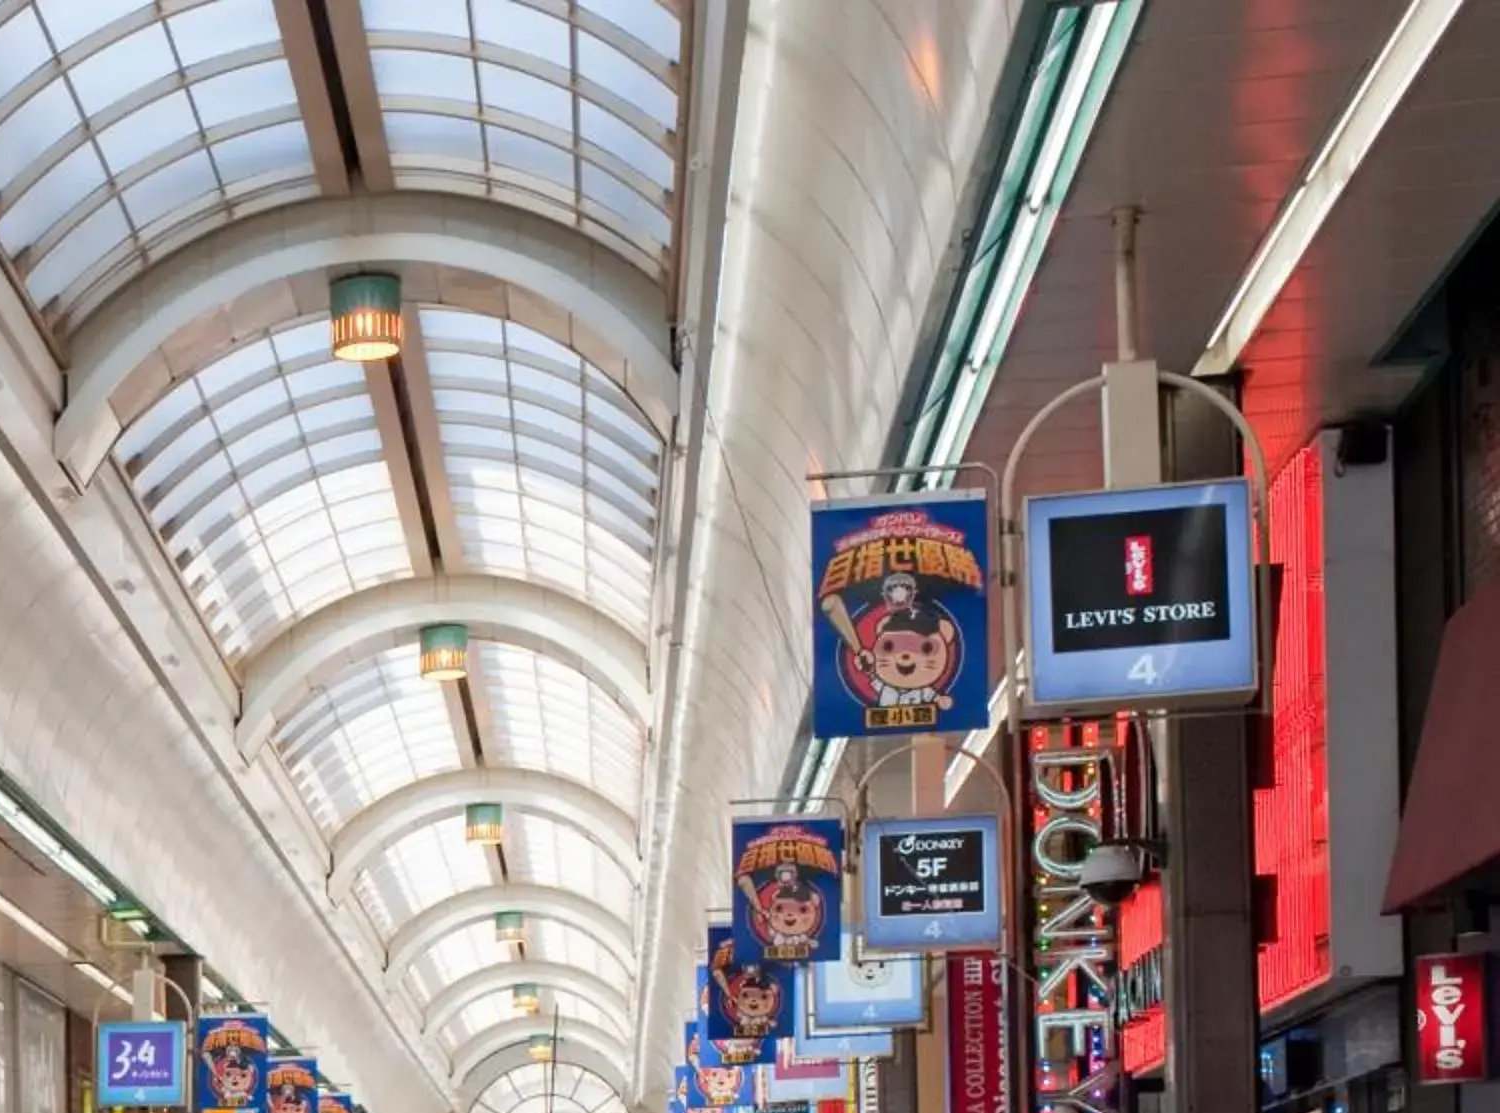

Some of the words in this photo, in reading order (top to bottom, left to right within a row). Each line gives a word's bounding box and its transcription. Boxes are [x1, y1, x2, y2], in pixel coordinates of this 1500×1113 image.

[820, 536, 983, 598] 目指せ優勝
[1065, 608, 1136, 629] LEVI'S
[1143, 601, 1216, 624] STORE
[1127, 653, 1157, 685] 4
[916, 857, 948, 877] 5F
[963, 989, 985, 1099] COLLECTION
